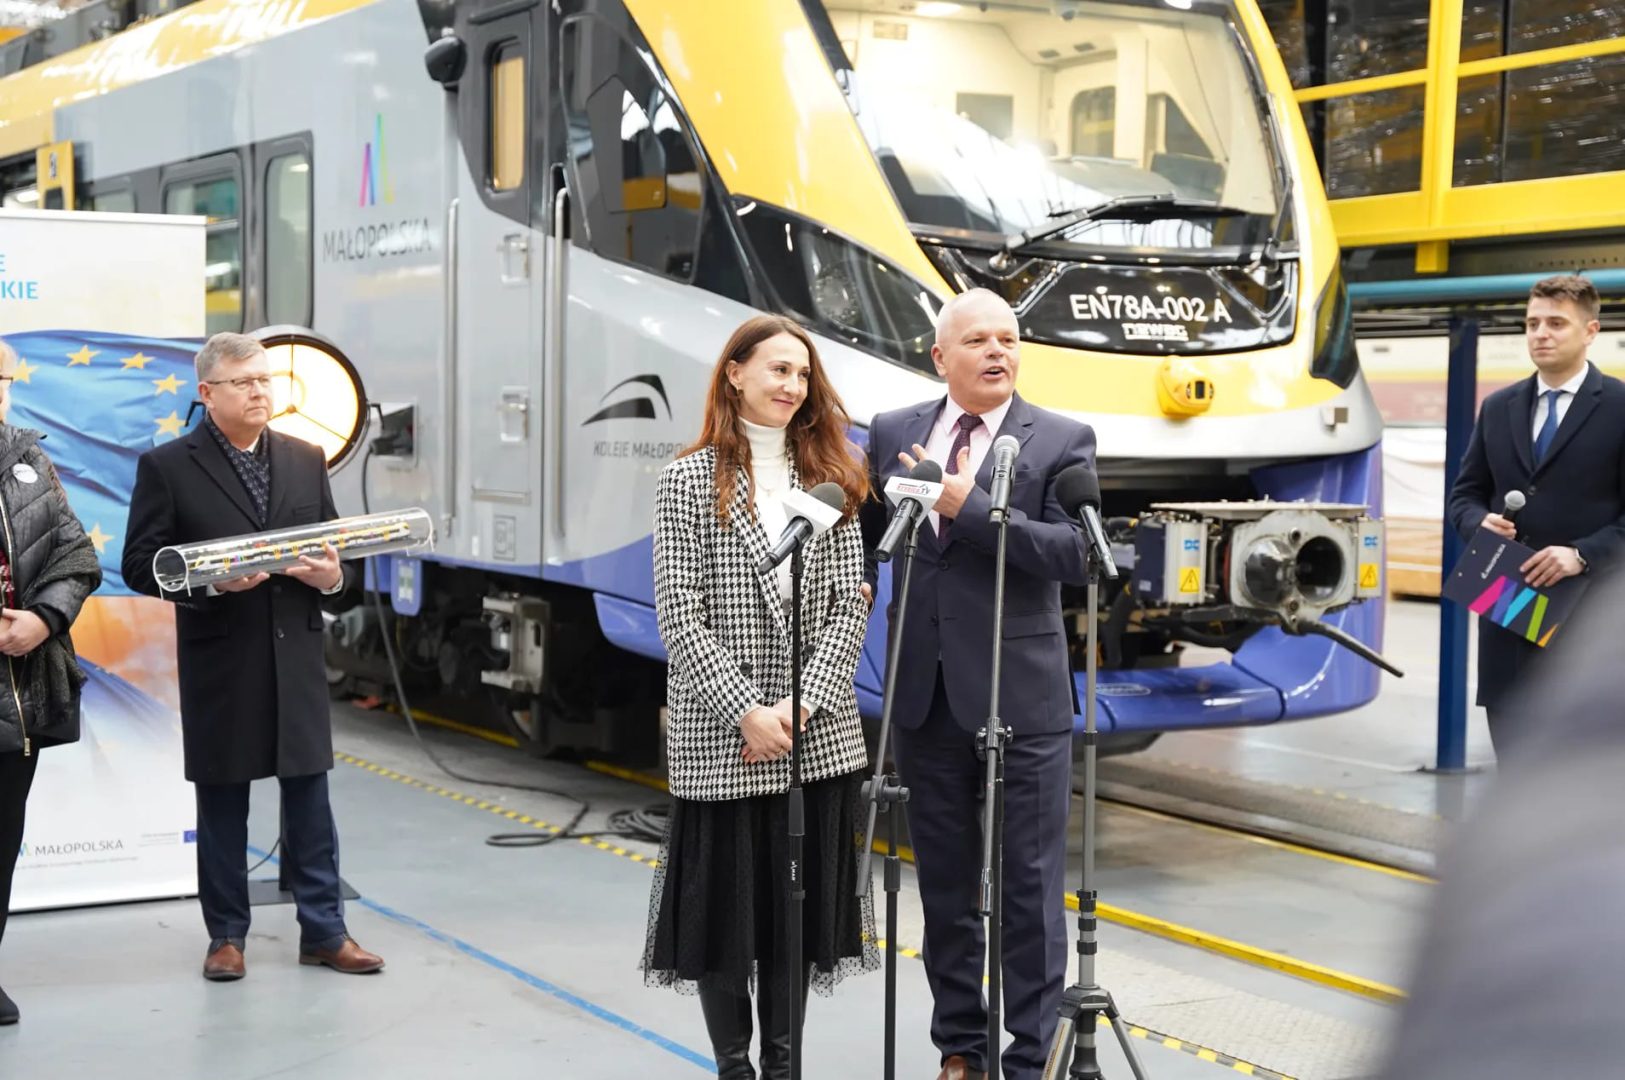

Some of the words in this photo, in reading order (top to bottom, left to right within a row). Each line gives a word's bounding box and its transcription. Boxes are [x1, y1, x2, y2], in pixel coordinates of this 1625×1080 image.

[1069, 294, 1209, 322] EN78A-002
[1213, 298, 1233, 324] A
[34, 839, 124, 856] MAŁOPOLSKA
